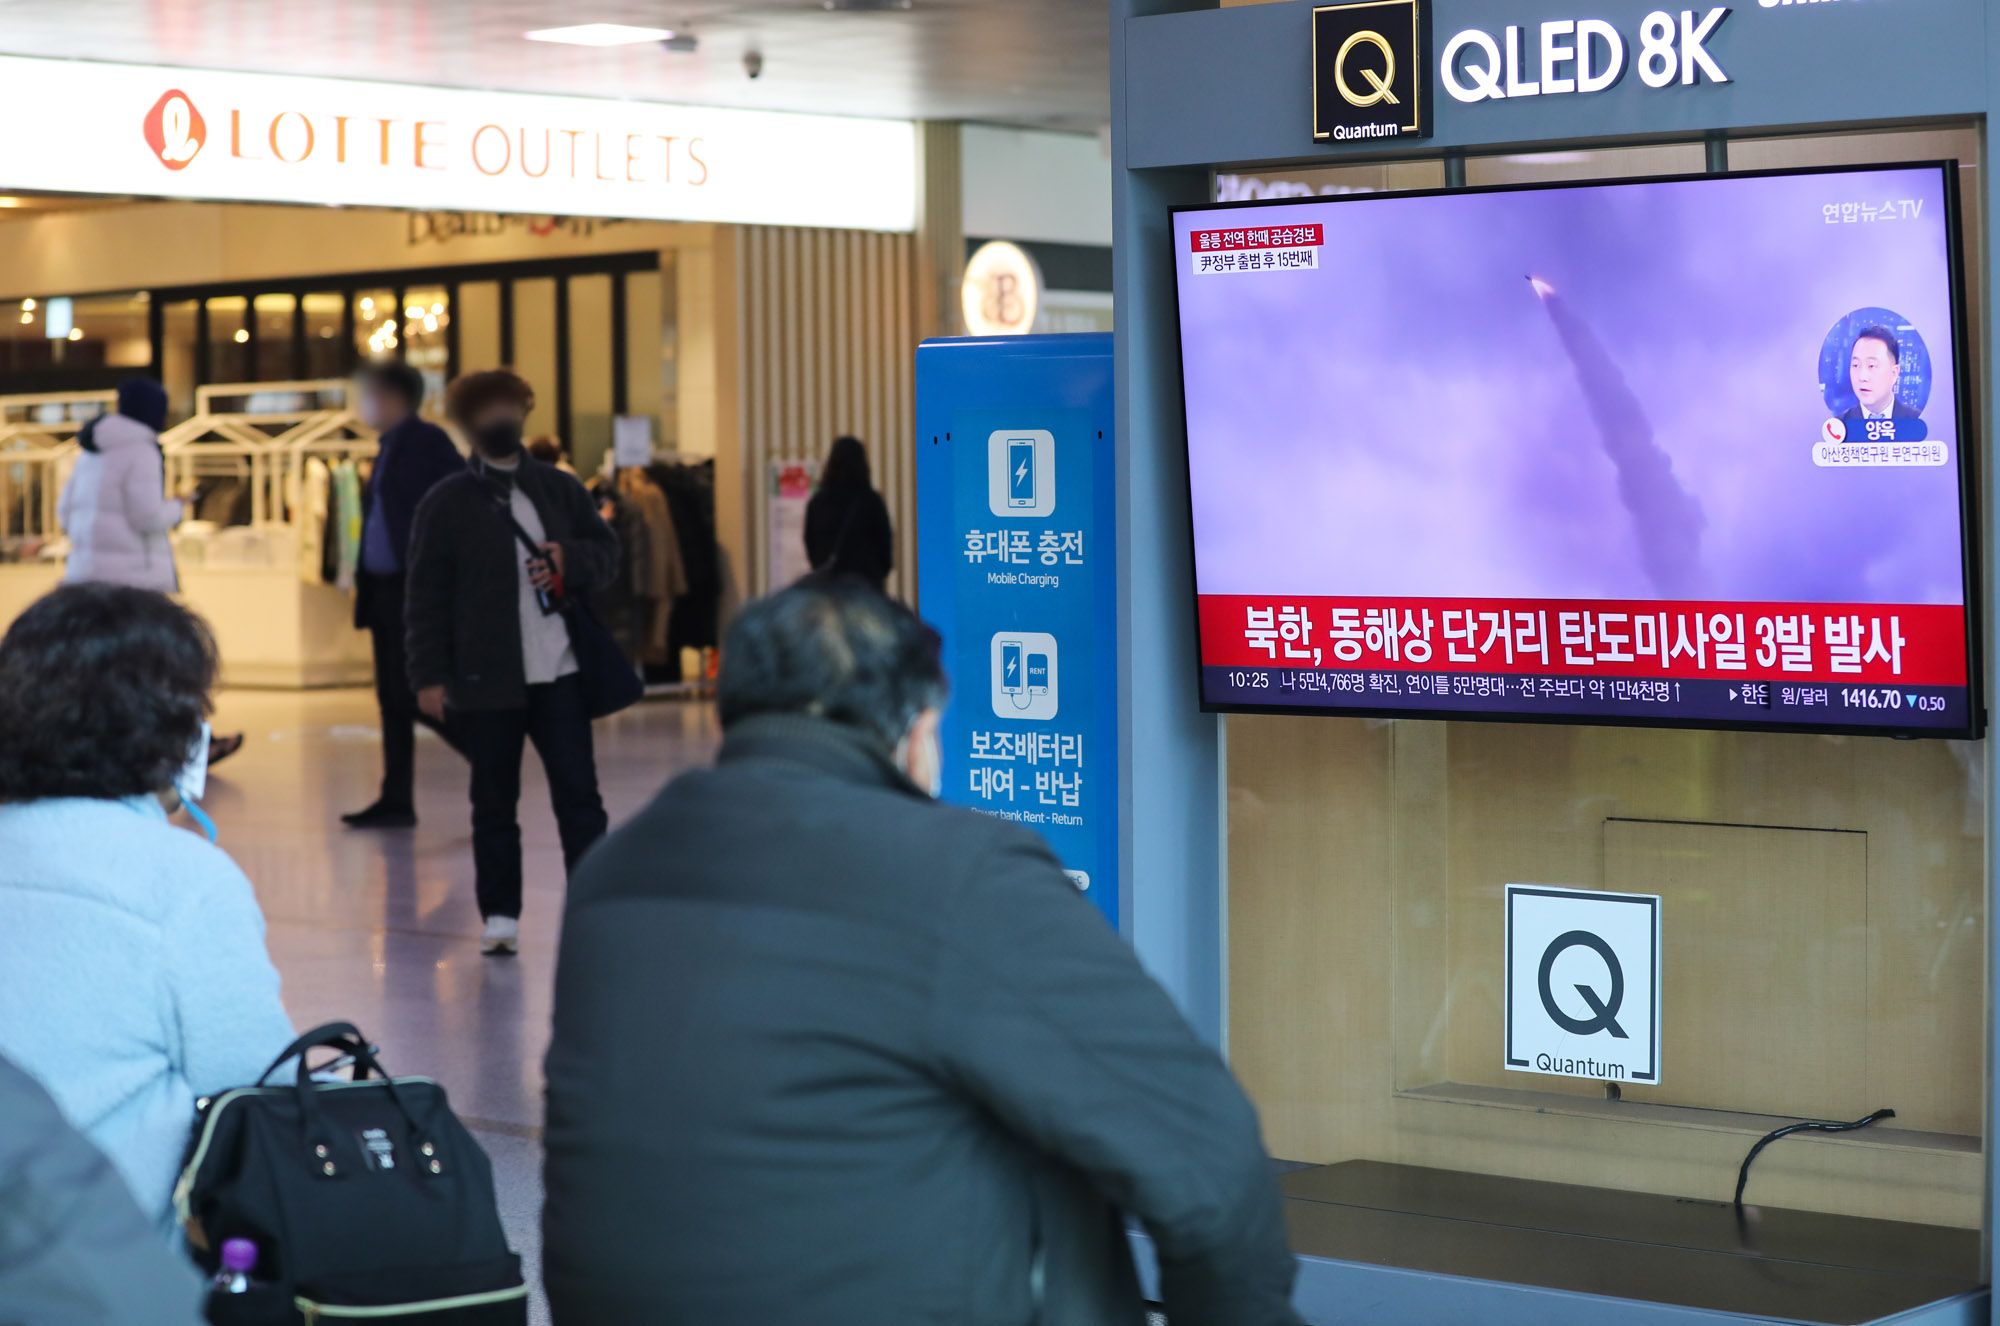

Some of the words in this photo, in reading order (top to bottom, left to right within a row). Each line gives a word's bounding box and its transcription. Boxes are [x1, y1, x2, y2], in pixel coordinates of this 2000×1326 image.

[1440, 20, 1623, 102] QLED
[1637, 7, 1729, 88] 8K
[1334, 30, 1400, 107] Q
[1333, 122, 1398, 140] Quantum
[230, 109, 447, 170] LOTTE
[472, 124, 708, 186] OUTLETS
[1822, 199, 1924, 224] 연합뉴스TV
[1199, 232, 1221, 250] 울릉
[1223, 230, 1245, 248] 전역
[1247, 229, 1269, 246] 한때
[1271, 226, 1316, 246] 공습경보
[1201, 254, 1235, 272] 尹정부
[1237, 252, 1260, 270] 출범
[1263, 251, 1275, 269] 후
[1277, 250, 1313, 267] 15번째
[1865, 420, 1896, 441] 양욱
[1822, 446, 1889, 463] 아산정책연구원
[1892, 445, 1941, 462] 부연구위원
[963, 529, 1032, 564] 휴대폰
[1037, 530, 1083, 565] 충전
[987, 572, 1017, 584] Mobile
[1018, 573, 1059, 588] Charging
[1244, 606, 1322, 667] 북한,
[1329, 607, 1434, 663] 동해상
[1442, 608, 1549, 665] 단거리
[1558, 610, 1747, 671] 탄도미사일
[1755, 615, 1815, 672] 3발
[1824, 615, 1906, 675] 발사
[1029, 667, 1046, 675] RENT
[1228, 672, 1269, 688] 10:25
[1299, 671, 1365, 693] 5만4,766명
[1369, 673, 1402, 695] 확진,
[1406, 674, 1450, 695] 연이틀
[1539, 678, 1585, 700] 주보다
[1588, 679, 1605, 700] 약
[1609, 680, 1670, 702] 1만4천명
[1781, 687, 1828, 706] 원/달러
[1841, 688, 1901, 709] 1416.70
[1918, 696, 1946, 712] 0.50
[970, 731, 1083, 768] 보조배터리
[970, 767, 1014, 801] 대여
[1035, 770, 1083, 807] 반납
[1000, 809, 1022, 822] bank
[1023, 811, 1045, 824] Rent
[1051, 813, 1083, 826] Return
[1537, 929, 1630, 1039] Q
[1536, 1052, 1625, 1079] Quantum
